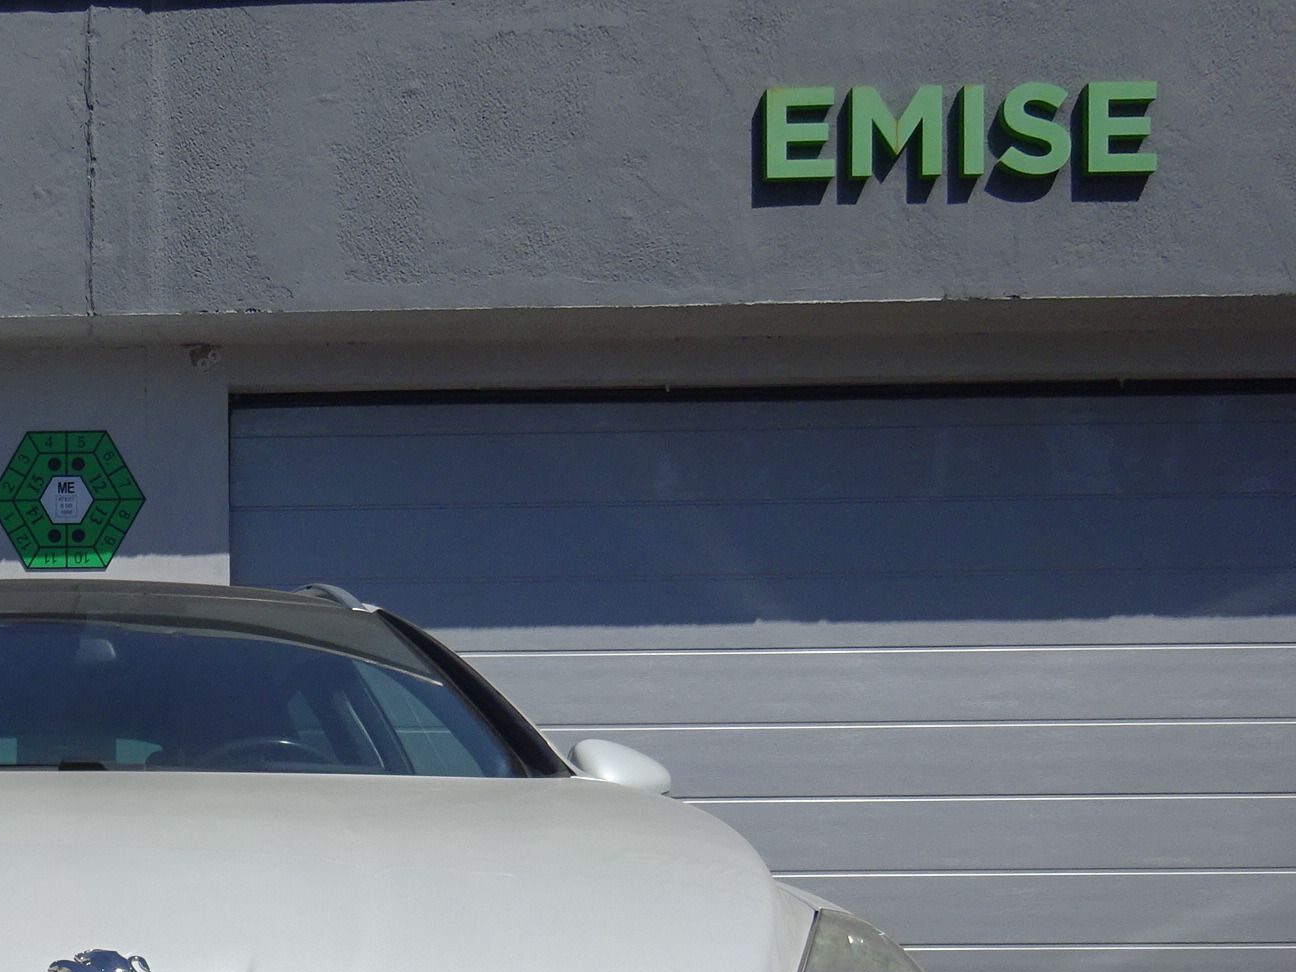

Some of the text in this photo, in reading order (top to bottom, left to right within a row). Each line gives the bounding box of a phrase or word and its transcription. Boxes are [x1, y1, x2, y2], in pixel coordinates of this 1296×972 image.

[763, 80, 1158, 183] EMISE
[44, 436, 53, 448] 4
[77, 436, 86, 448] 5
[18, 454, 30, 465] 3
[3, 481, 15, 493] 2
[28, 473, 44, 493] 15
[57, 481, 75, 494] ME
[90, 505, 108, 525] 13
[119, 509, 131, 520] 8
